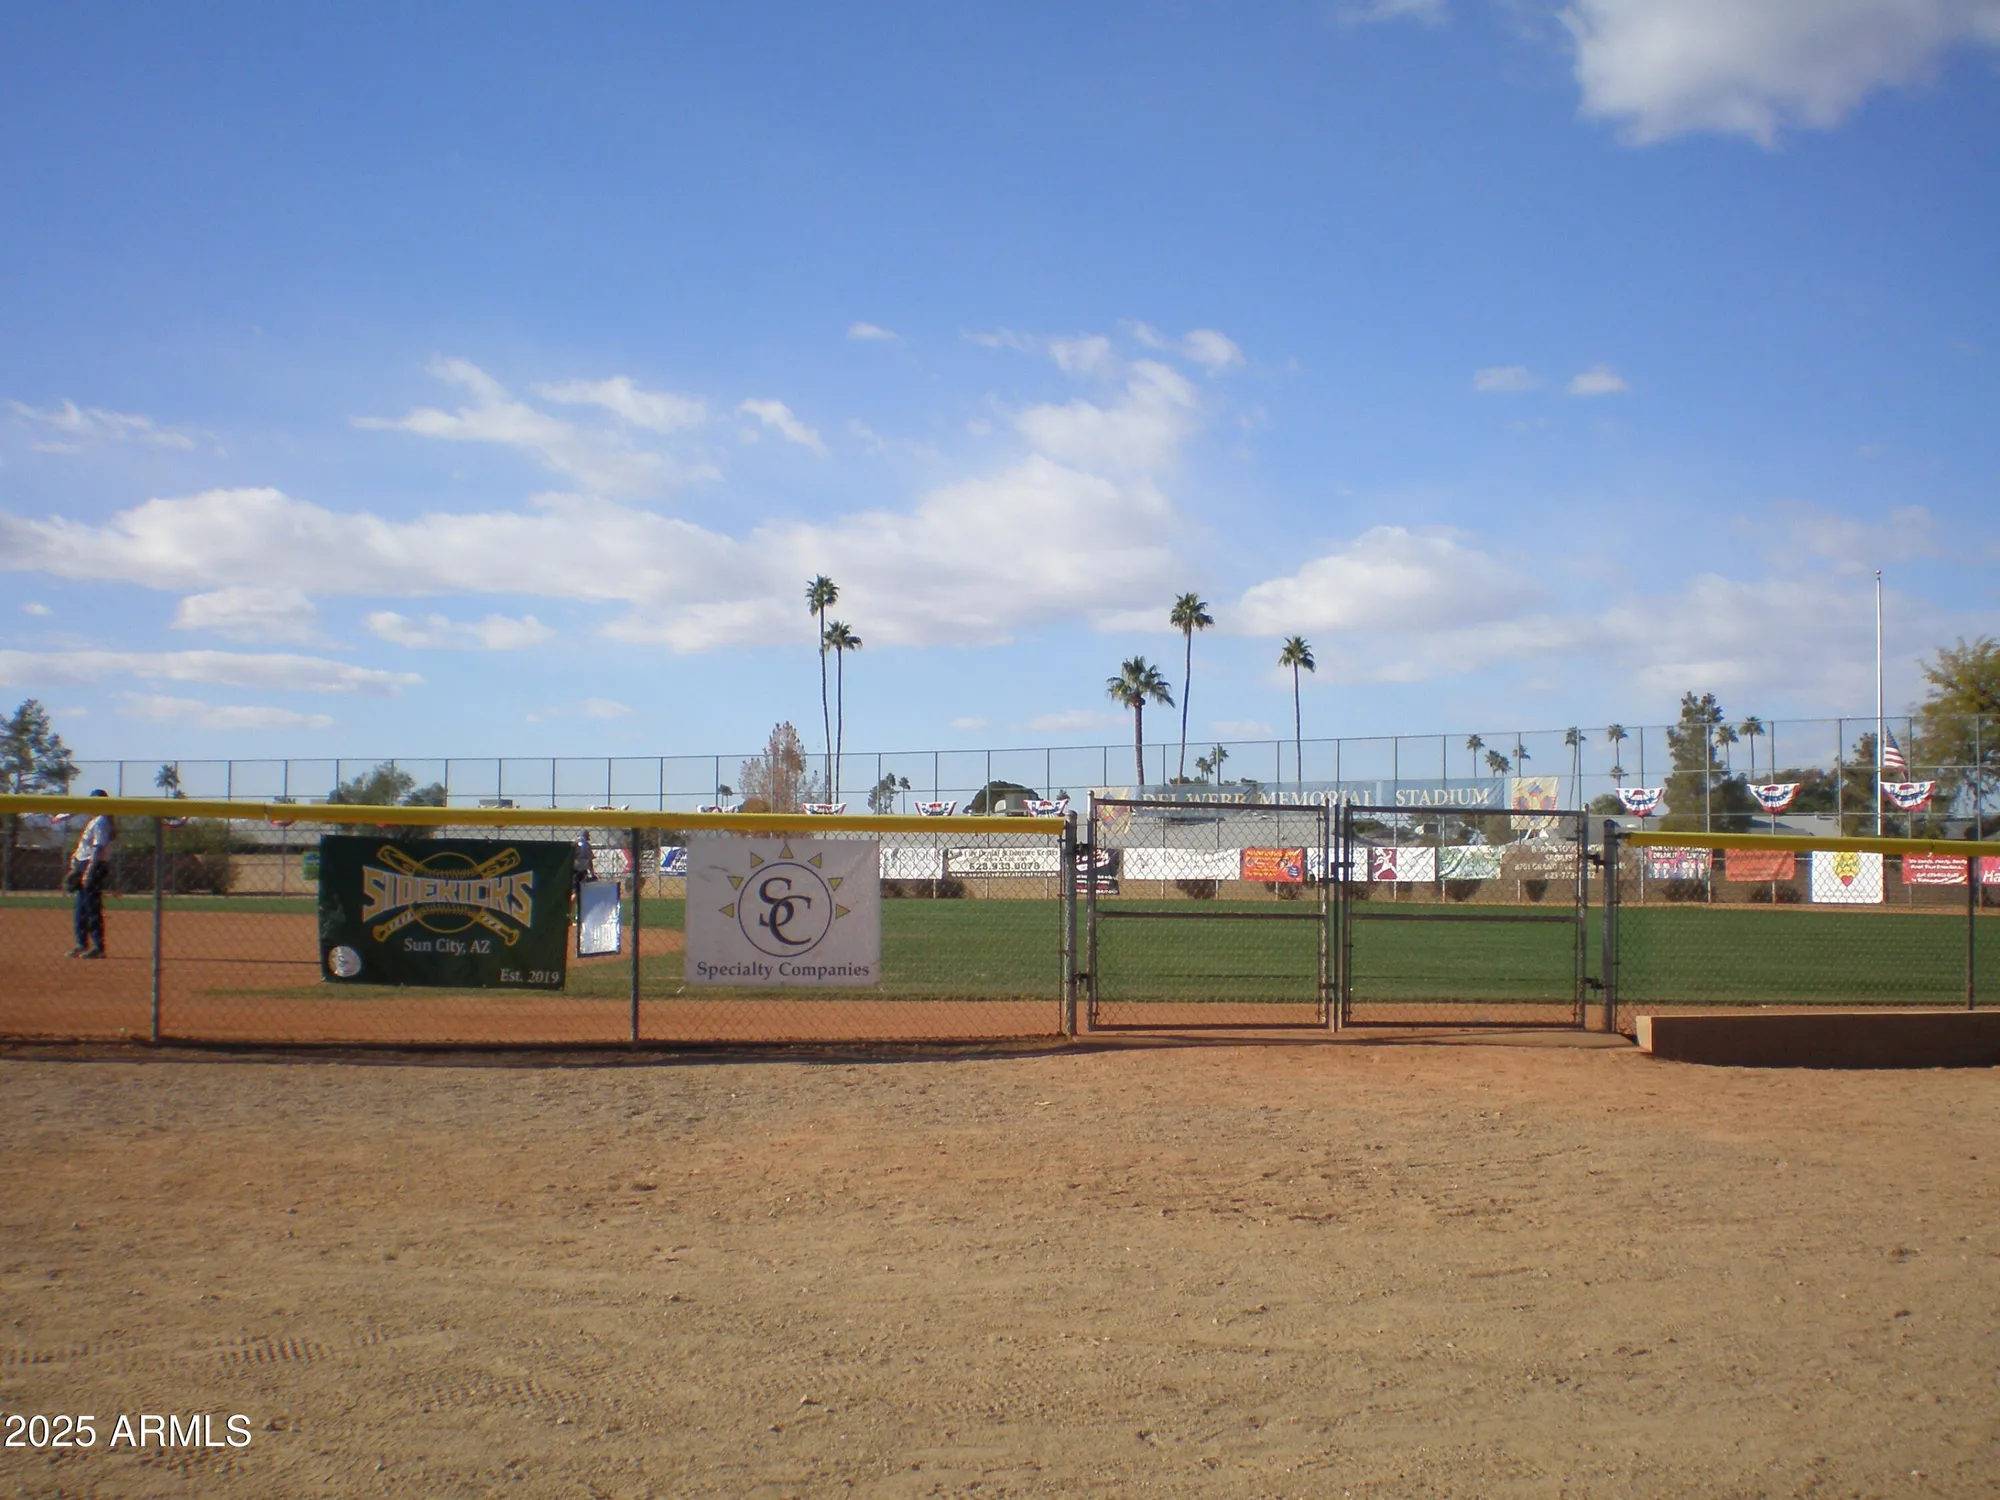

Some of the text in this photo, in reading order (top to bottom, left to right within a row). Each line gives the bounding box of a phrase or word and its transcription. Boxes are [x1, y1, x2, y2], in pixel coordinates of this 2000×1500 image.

[1142, 788, 1490, 811] DEL WEBB MEMORIAL STADIUM
[362, 865, 533, 928] SIDEKICKS
[403, 936, 491, 956] Sun City, AZ
[499, 968, 560, 985] Est. 2019
[697, 961, 870, 980] Specialty Companies
